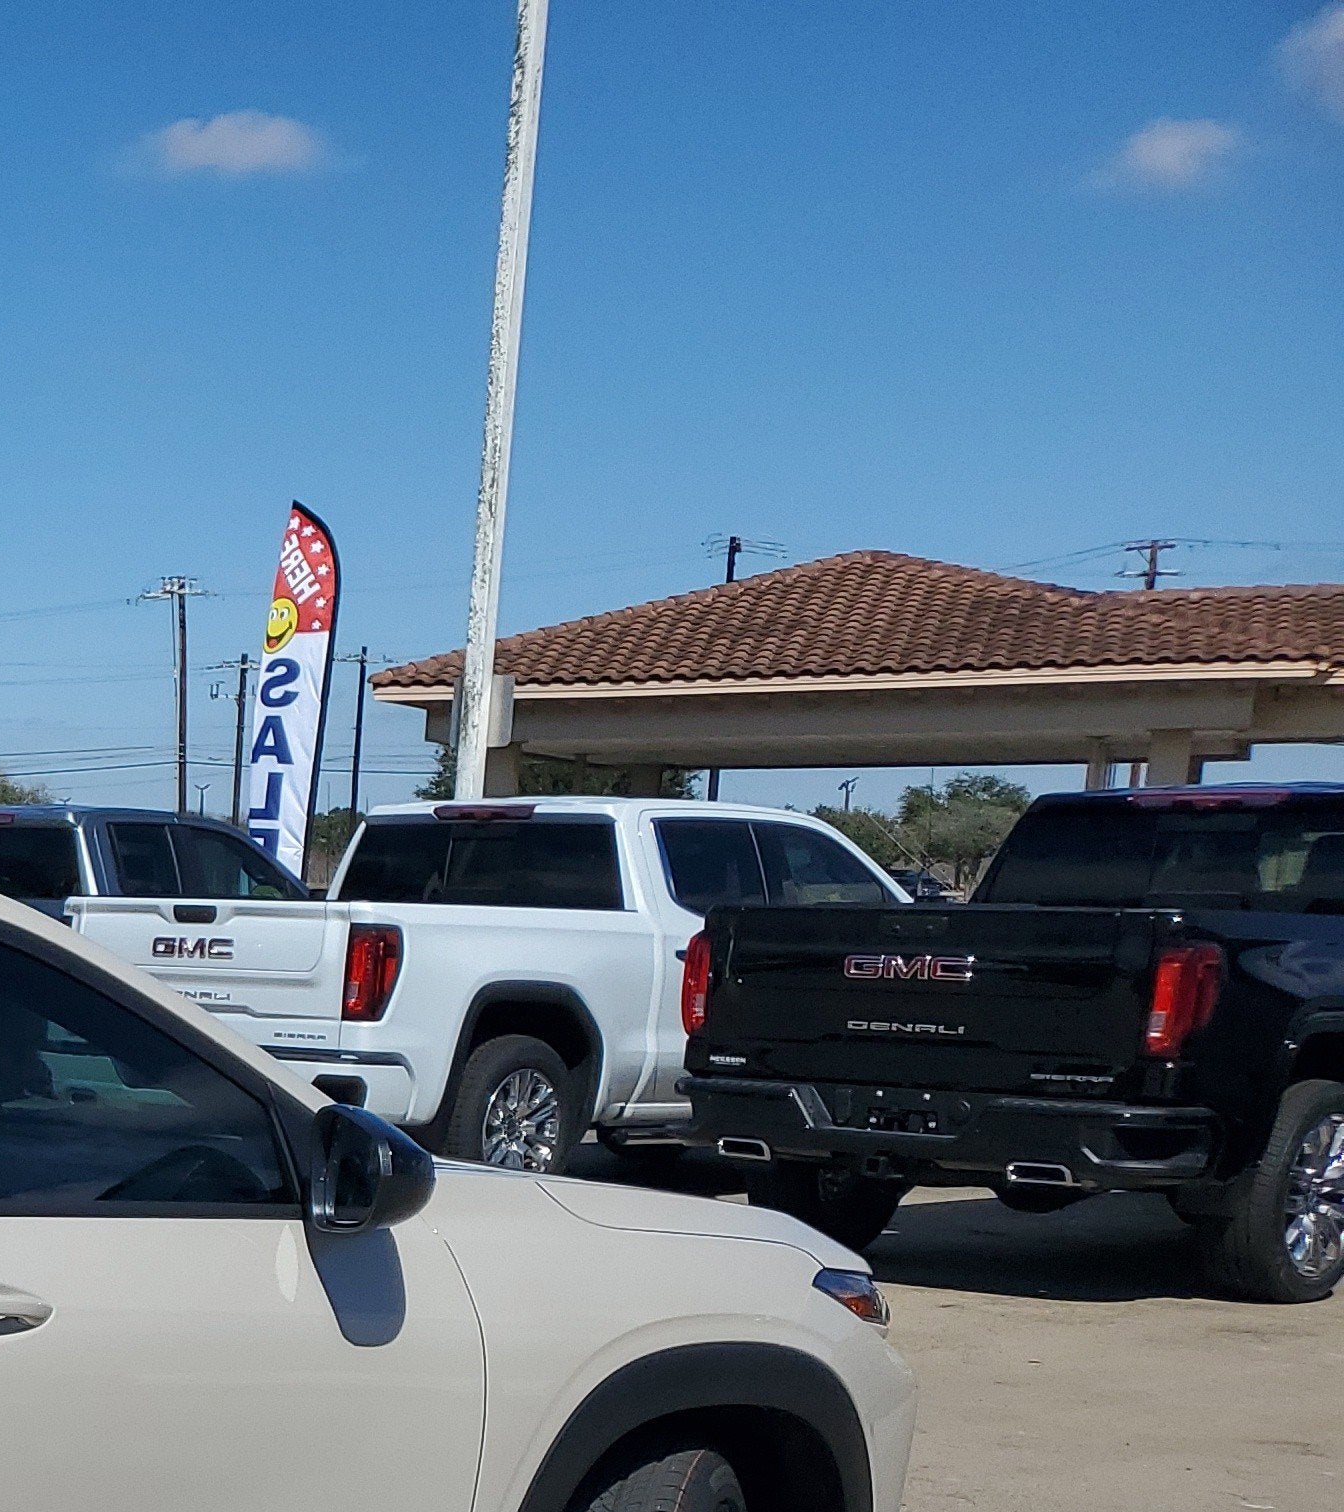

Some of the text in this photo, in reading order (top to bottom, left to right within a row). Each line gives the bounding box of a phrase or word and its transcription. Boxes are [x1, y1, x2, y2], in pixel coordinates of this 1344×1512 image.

[152, 937, 234, 960] GMC
[844, 954, 976, 982] GMC
[175, 990, 231, 1001] NALI
[847, 1020, 965, 1035] DENALI
